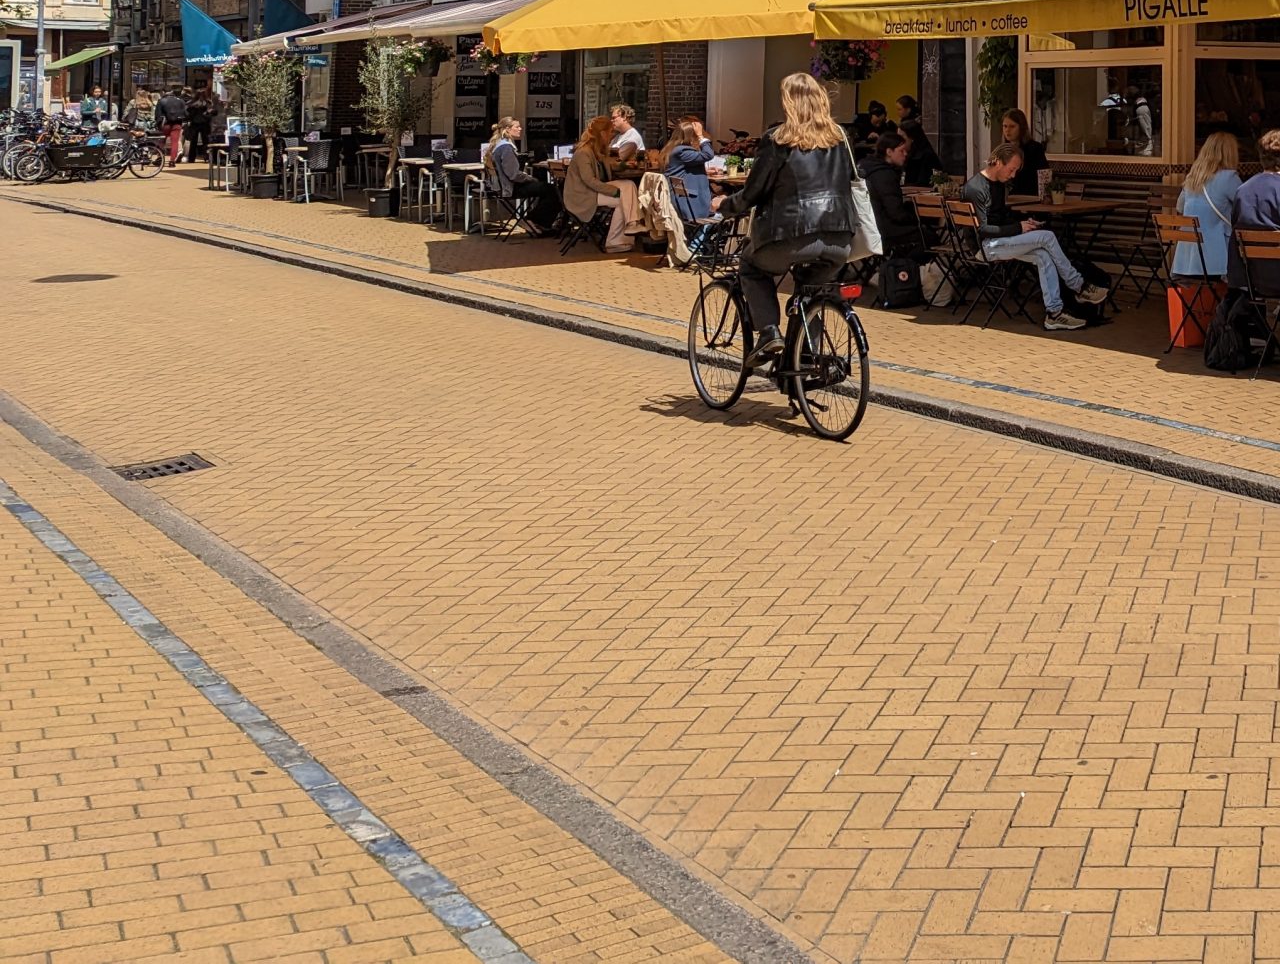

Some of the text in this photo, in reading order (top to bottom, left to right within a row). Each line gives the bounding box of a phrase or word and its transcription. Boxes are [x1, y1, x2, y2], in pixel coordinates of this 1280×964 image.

[884, 14, 1028, 34] breakfast lunch coffee
[458, 36, 481, 44] PAST
[456, 119, 484, 131] Lasagne
